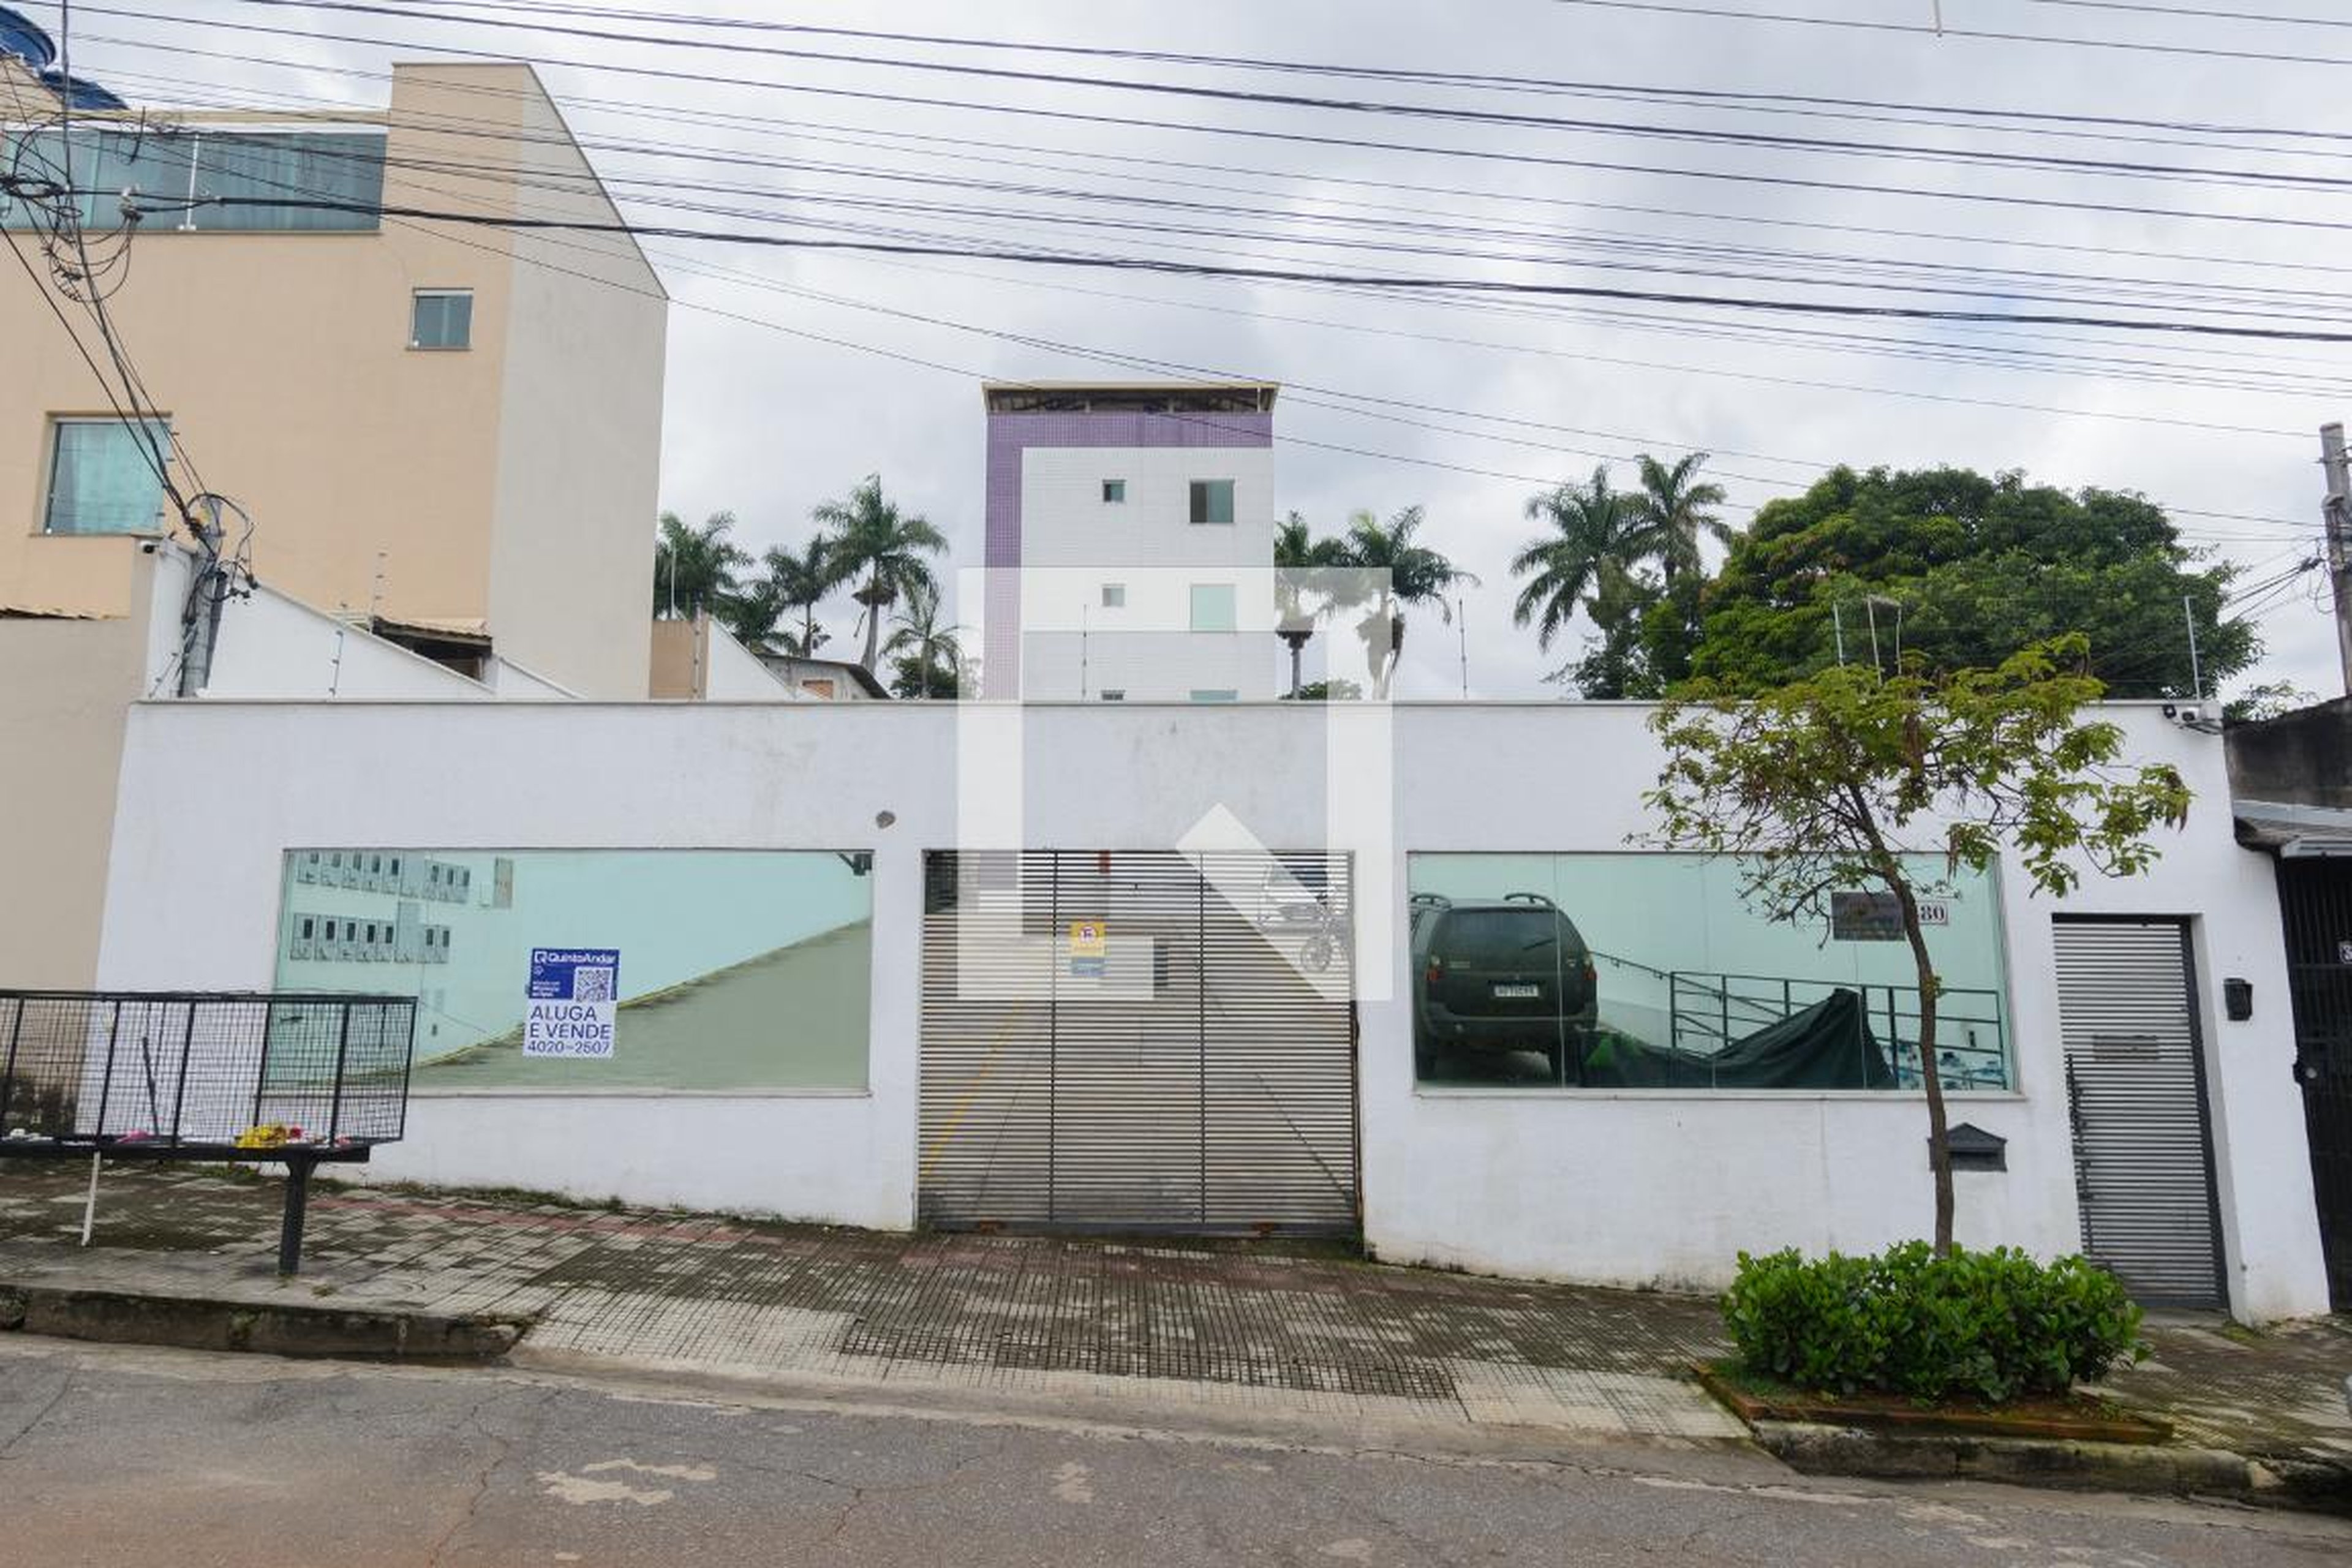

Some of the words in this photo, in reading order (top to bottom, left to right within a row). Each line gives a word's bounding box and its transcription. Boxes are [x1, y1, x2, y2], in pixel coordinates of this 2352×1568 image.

[530, 1006, 597, 1021] ALUGA
[530, 1022, 540, 1038] E
[546, 1023, 611, 1039] VENDE
[527, 1041, 609, 1054] 4020-2507
